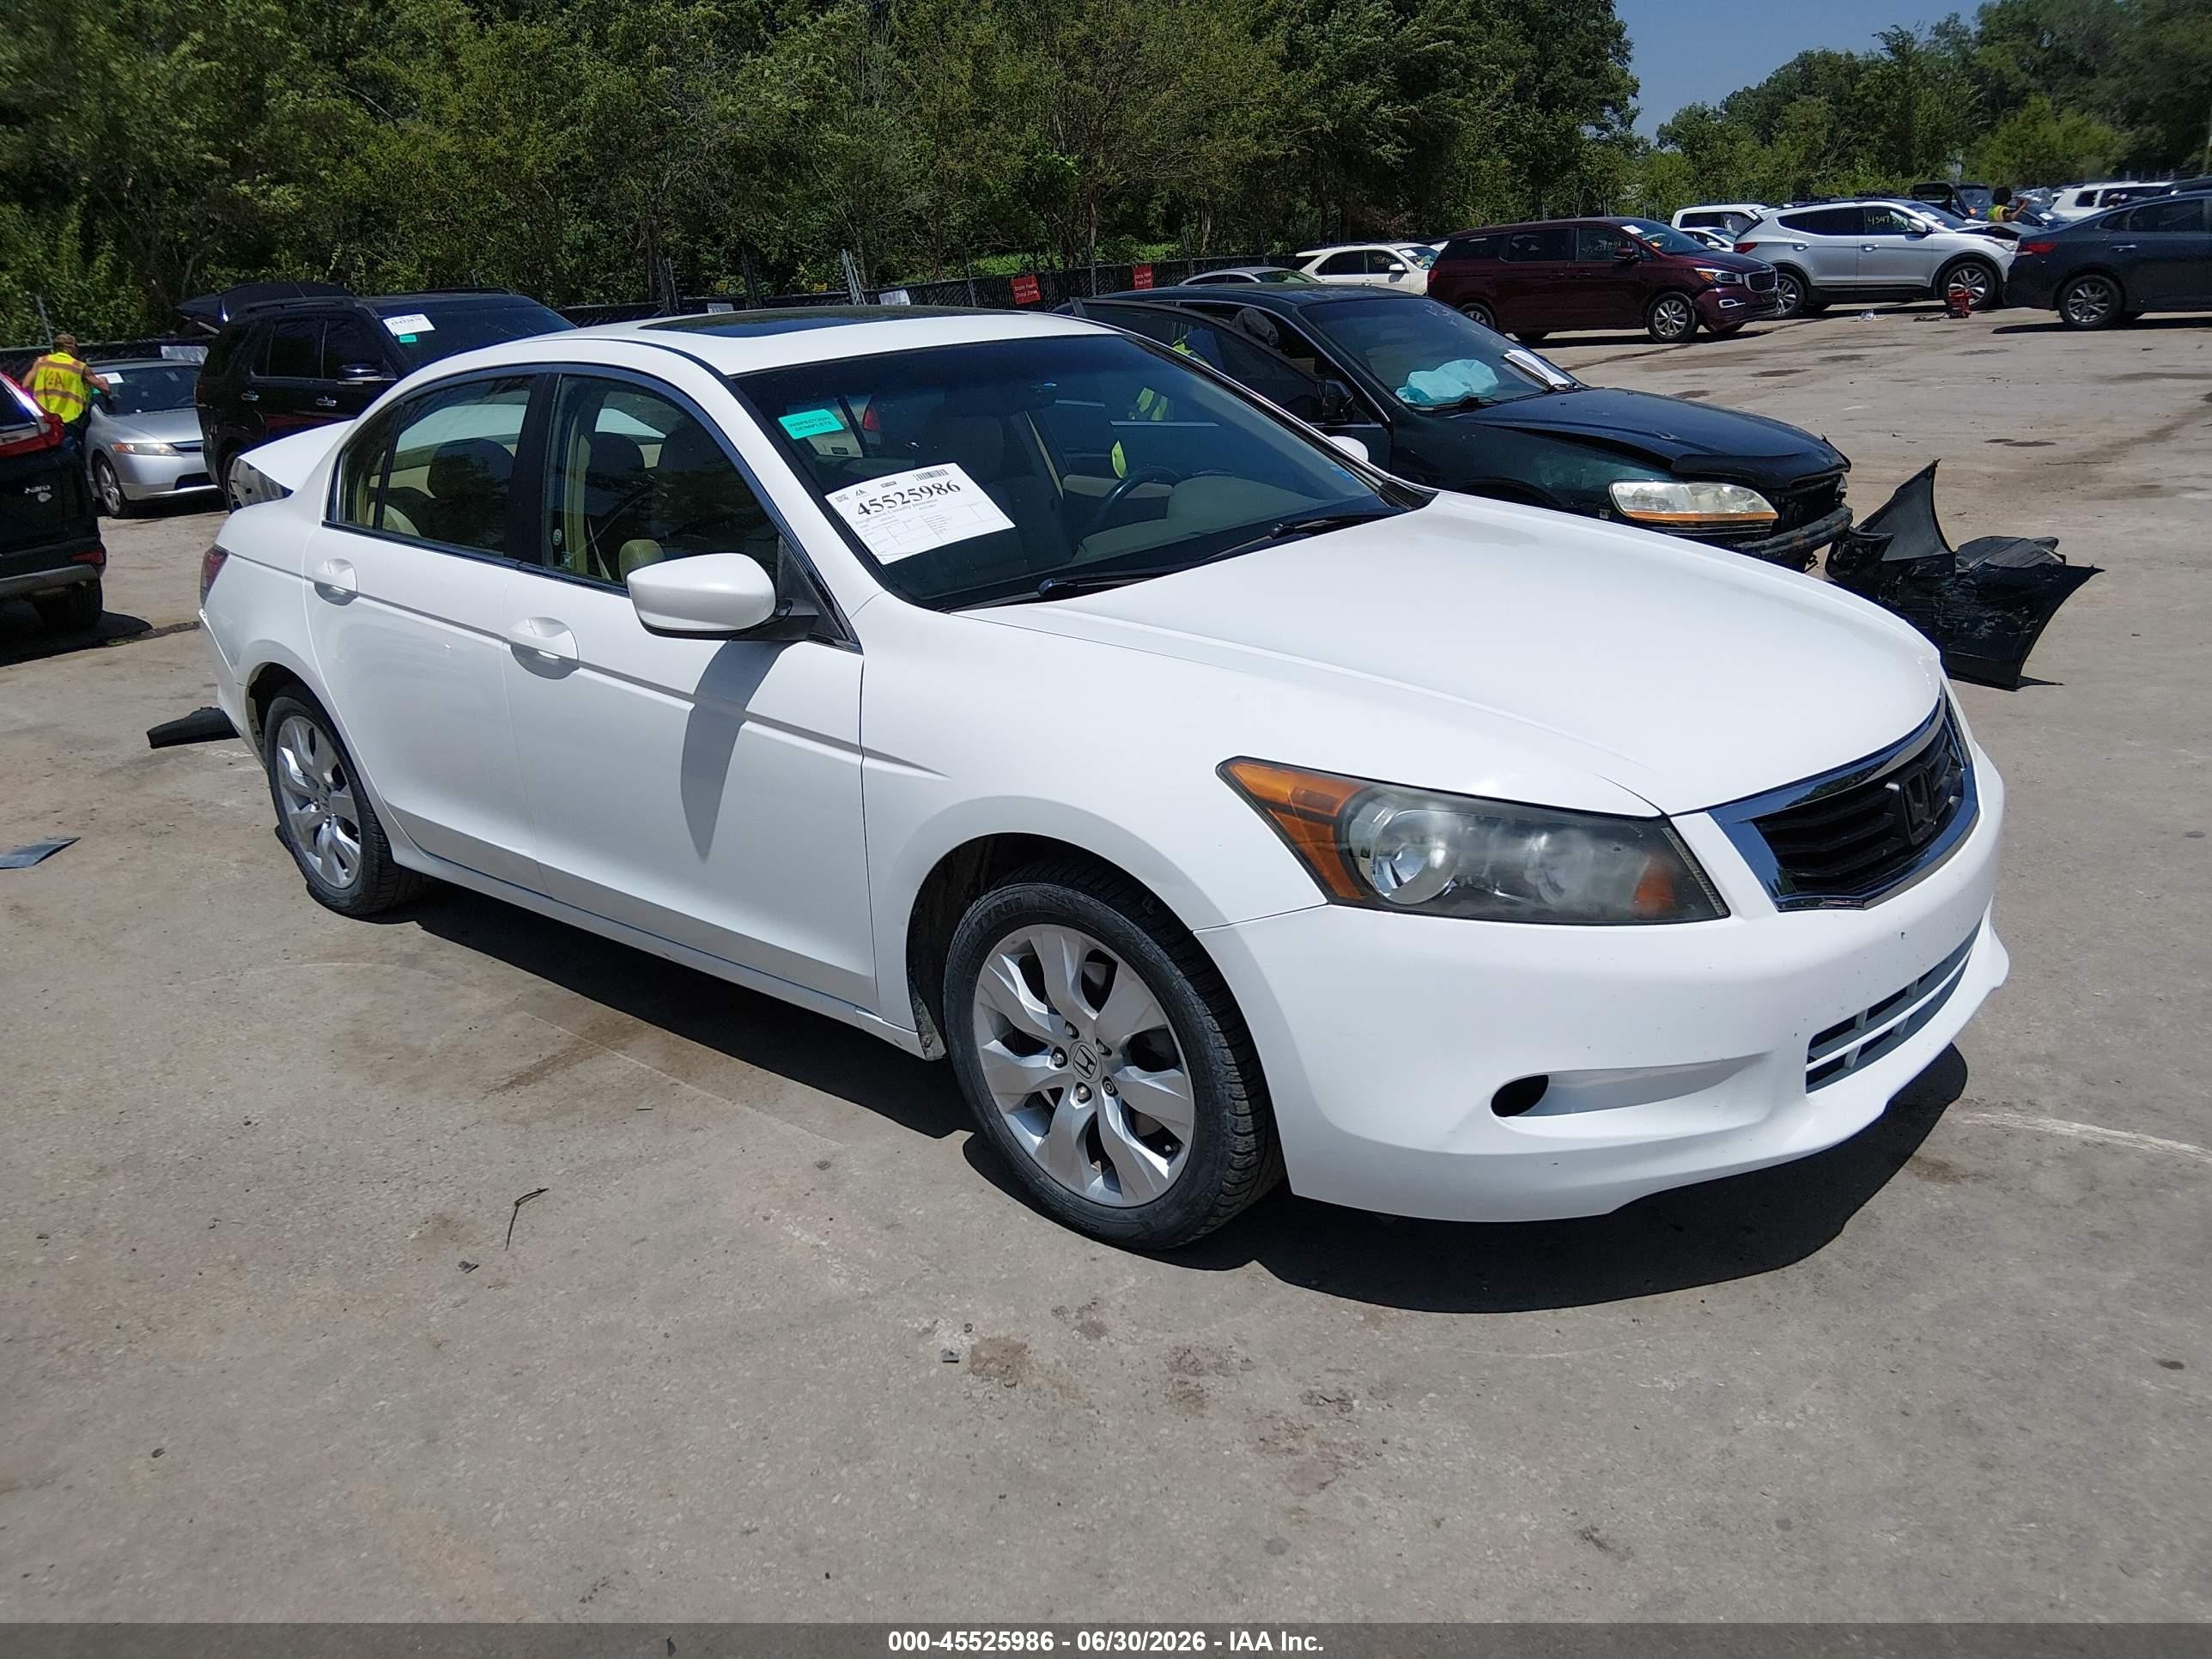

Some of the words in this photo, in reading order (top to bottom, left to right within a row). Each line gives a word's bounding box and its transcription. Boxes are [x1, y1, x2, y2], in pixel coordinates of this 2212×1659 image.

[787, 416, 830, 428] INSPECTION
[794, 421, 834, 432] COMPLETE
[857, 479, 961, 516] 45525986
